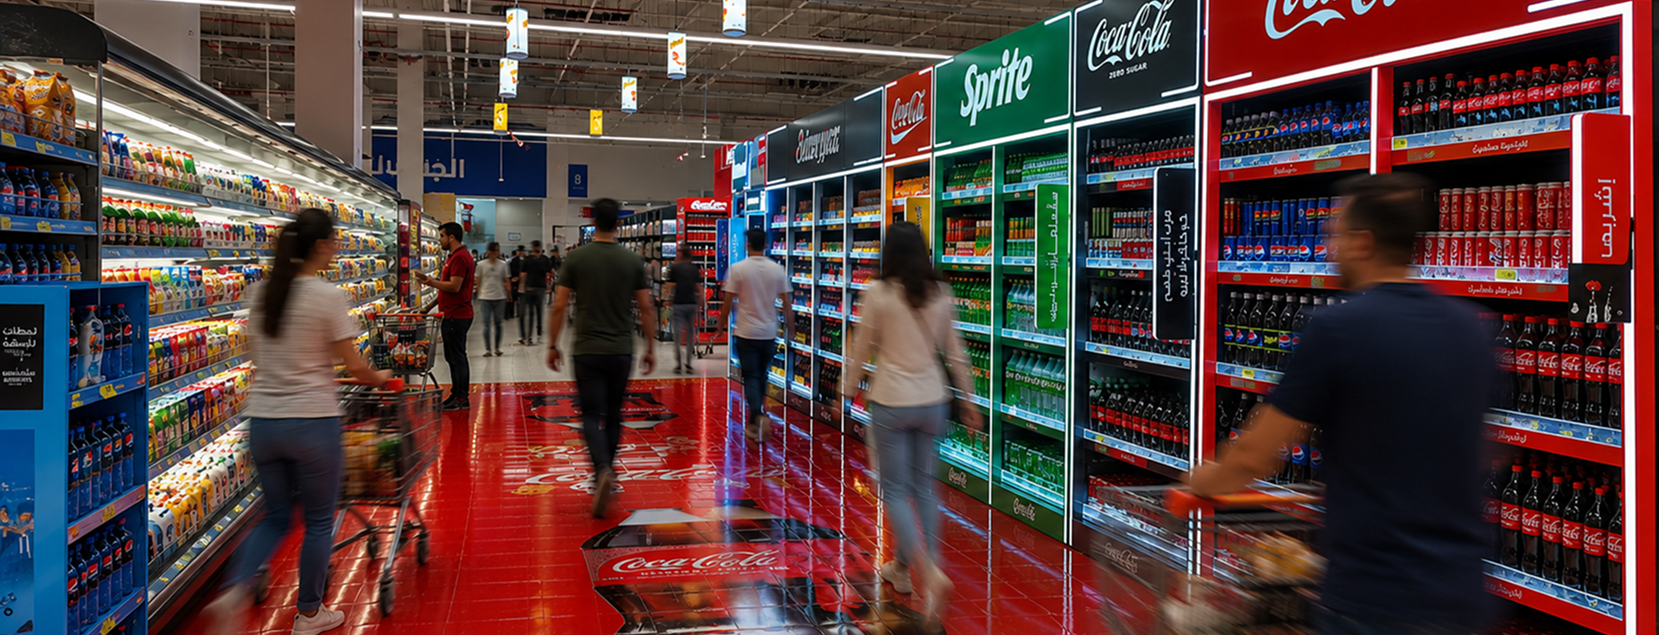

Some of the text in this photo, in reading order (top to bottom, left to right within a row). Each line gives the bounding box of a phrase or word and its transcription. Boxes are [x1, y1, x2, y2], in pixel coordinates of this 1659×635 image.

[1126, 62, 1147, 75] SUGAR
[960, 47, 1033, 126] Sprite
[612, 549, 780, 573] Coca-Cola
